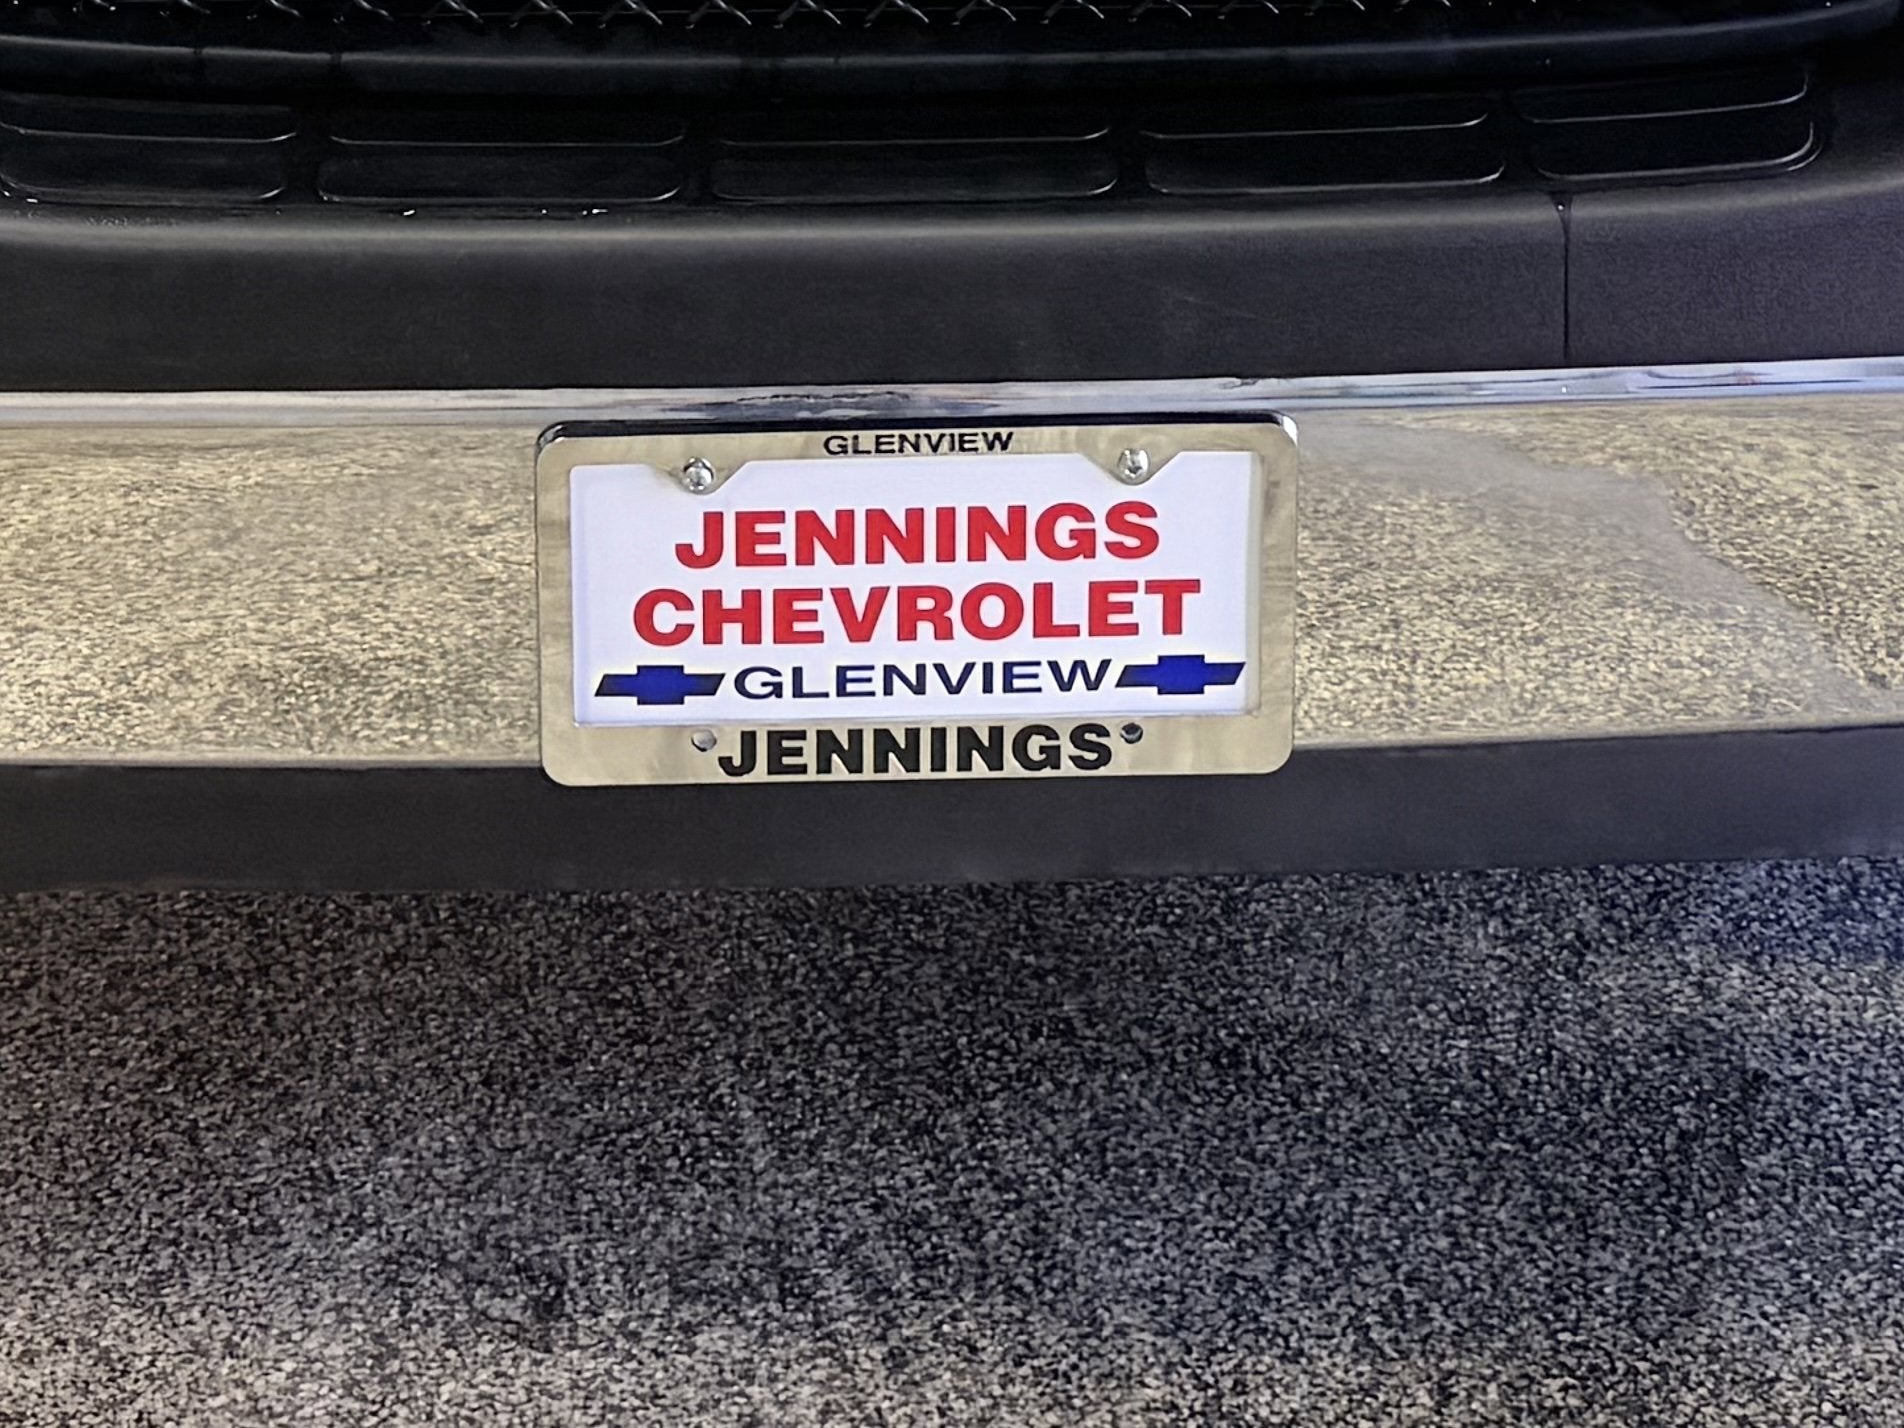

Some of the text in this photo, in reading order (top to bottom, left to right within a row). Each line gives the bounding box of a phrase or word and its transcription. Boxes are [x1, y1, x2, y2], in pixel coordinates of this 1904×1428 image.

[823, 430, 1014, 456] GLENVIEW
[675, 501, 1160, 570] JENNINGS
[633, 578, 1201, 647] CHEVROLET
[733, 658, 1113, 700] GLENVIEW
[718, 722, 1113, 778] JENNINGS
